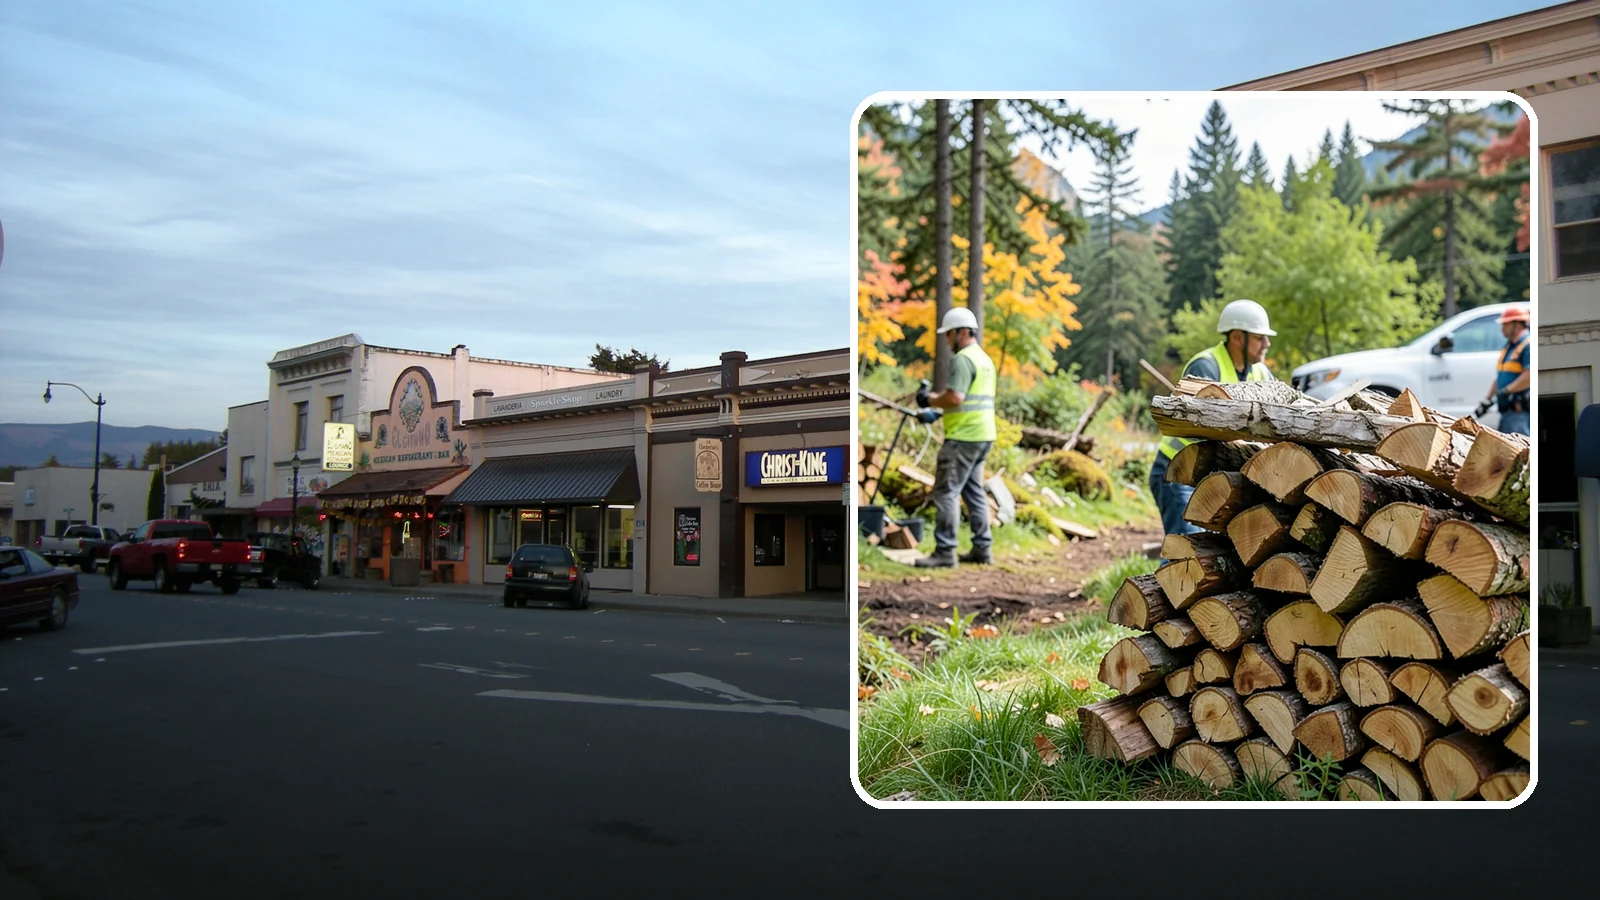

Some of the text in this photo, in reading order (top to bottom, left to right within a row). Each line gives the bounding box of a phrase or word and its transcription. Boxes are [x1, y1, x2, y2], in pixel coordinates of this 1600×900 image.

[531, 394, 582, 409] Sparkle Shop
[595, 389, 623, 400] LAUNDRY
[493, 402, 522, 412] LAVANDERIA
[373, 450, 450, 464] MEXICAN RESTAURANT BAR
[761, 450, 827, 477] CHRIST KING
